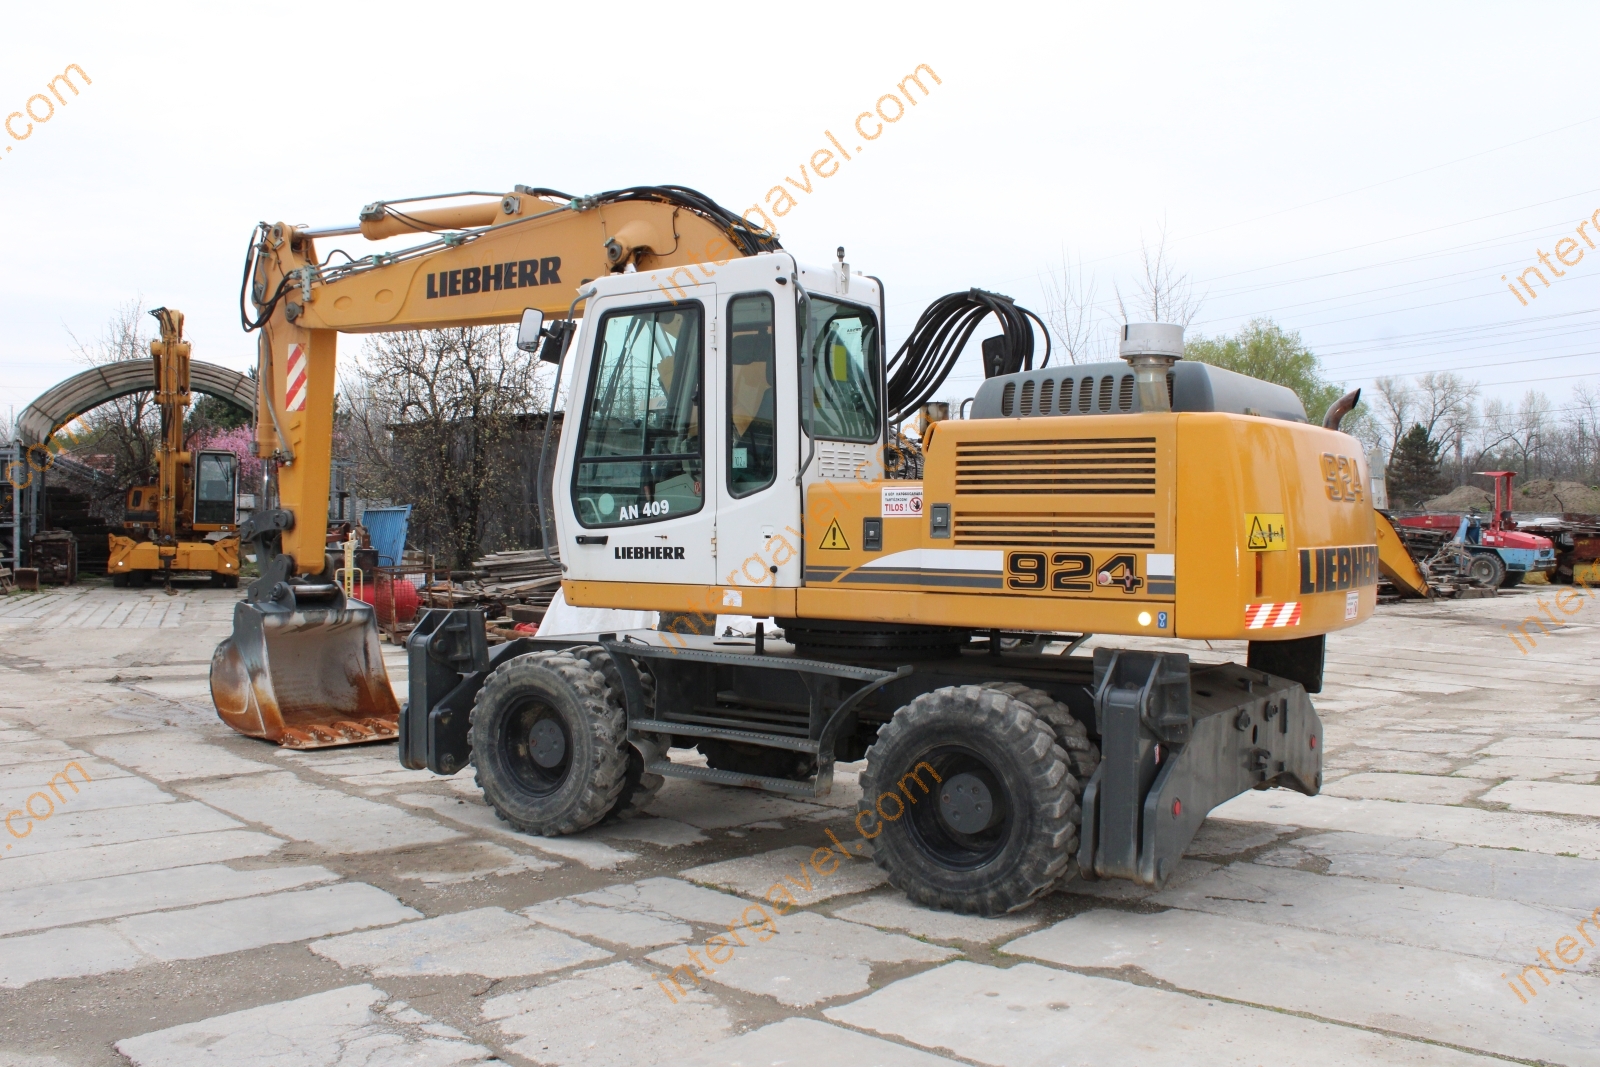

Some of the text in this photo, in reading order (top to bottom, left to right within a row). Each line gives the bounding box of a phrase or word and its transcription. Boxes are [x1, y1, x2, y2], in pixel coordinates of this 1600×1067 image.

[426, 256, 562, 299] LIEBHERR
[1319, 451, 1365, 505] 924
[619, 499, 670, 521] AN 409
[885, 503, 904, 512] TILOS
[614, 547, 685, 560] LIEBHERR
[1007, 551, 1144, 594] 924
